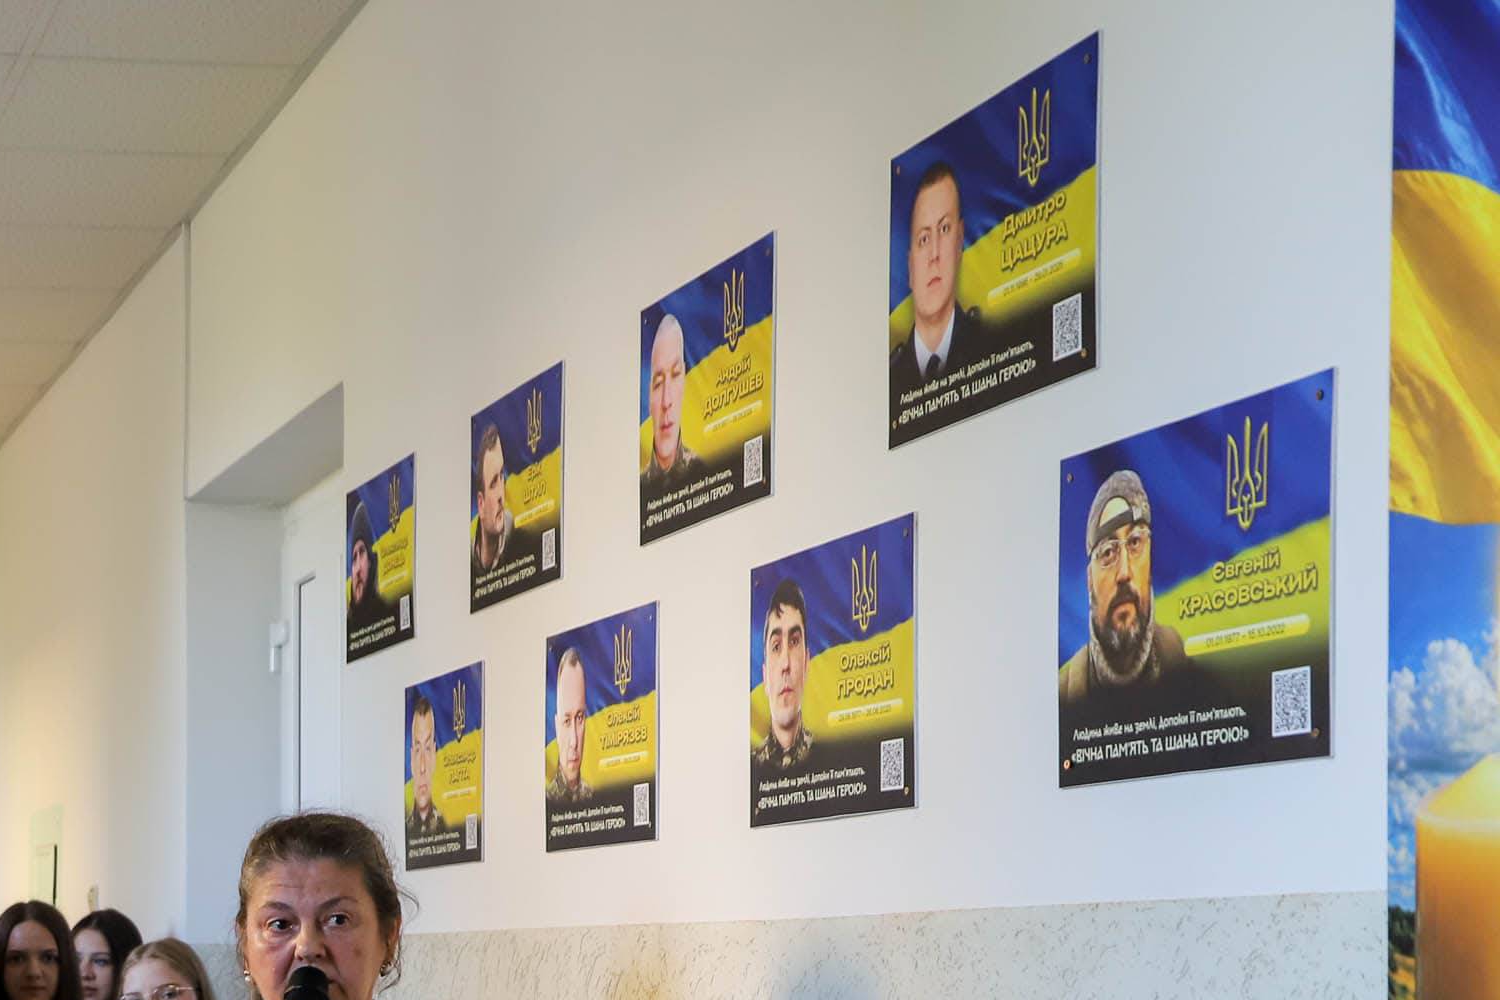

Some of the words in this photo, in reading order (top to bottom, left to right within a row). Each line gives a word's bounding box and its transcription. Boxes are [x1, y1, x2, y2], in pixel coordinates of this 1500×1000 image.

[1003, 190, 1066, 242] Дмитро
[1001, 220, 1068, 272] ЦАЦУРА
[703, 371, 763, 417] ДОЛГУШЕВ
[961, 384, 970, 398] ТА
[972, 373, 997, 394] ШАНА
[1212, 547, 1281, 583] Євгеній
[1179, 563, 1318, 619] КРАСОВСЬКИЙ
[840, 642, 890, 672] Олексій
[837, 667, 893, 701] ПРОДАН
[1073, 728, 1102, 741] Людина
[1104, 723, 1122, 736] живе
[1159, 713, 1188, 729] допоки
[1151, 738, 1163, 752] ТА
[1165, 733, 1198, 751] ШАНА
[1201, 726, 1249, 746] ГЕРОЮ!»
